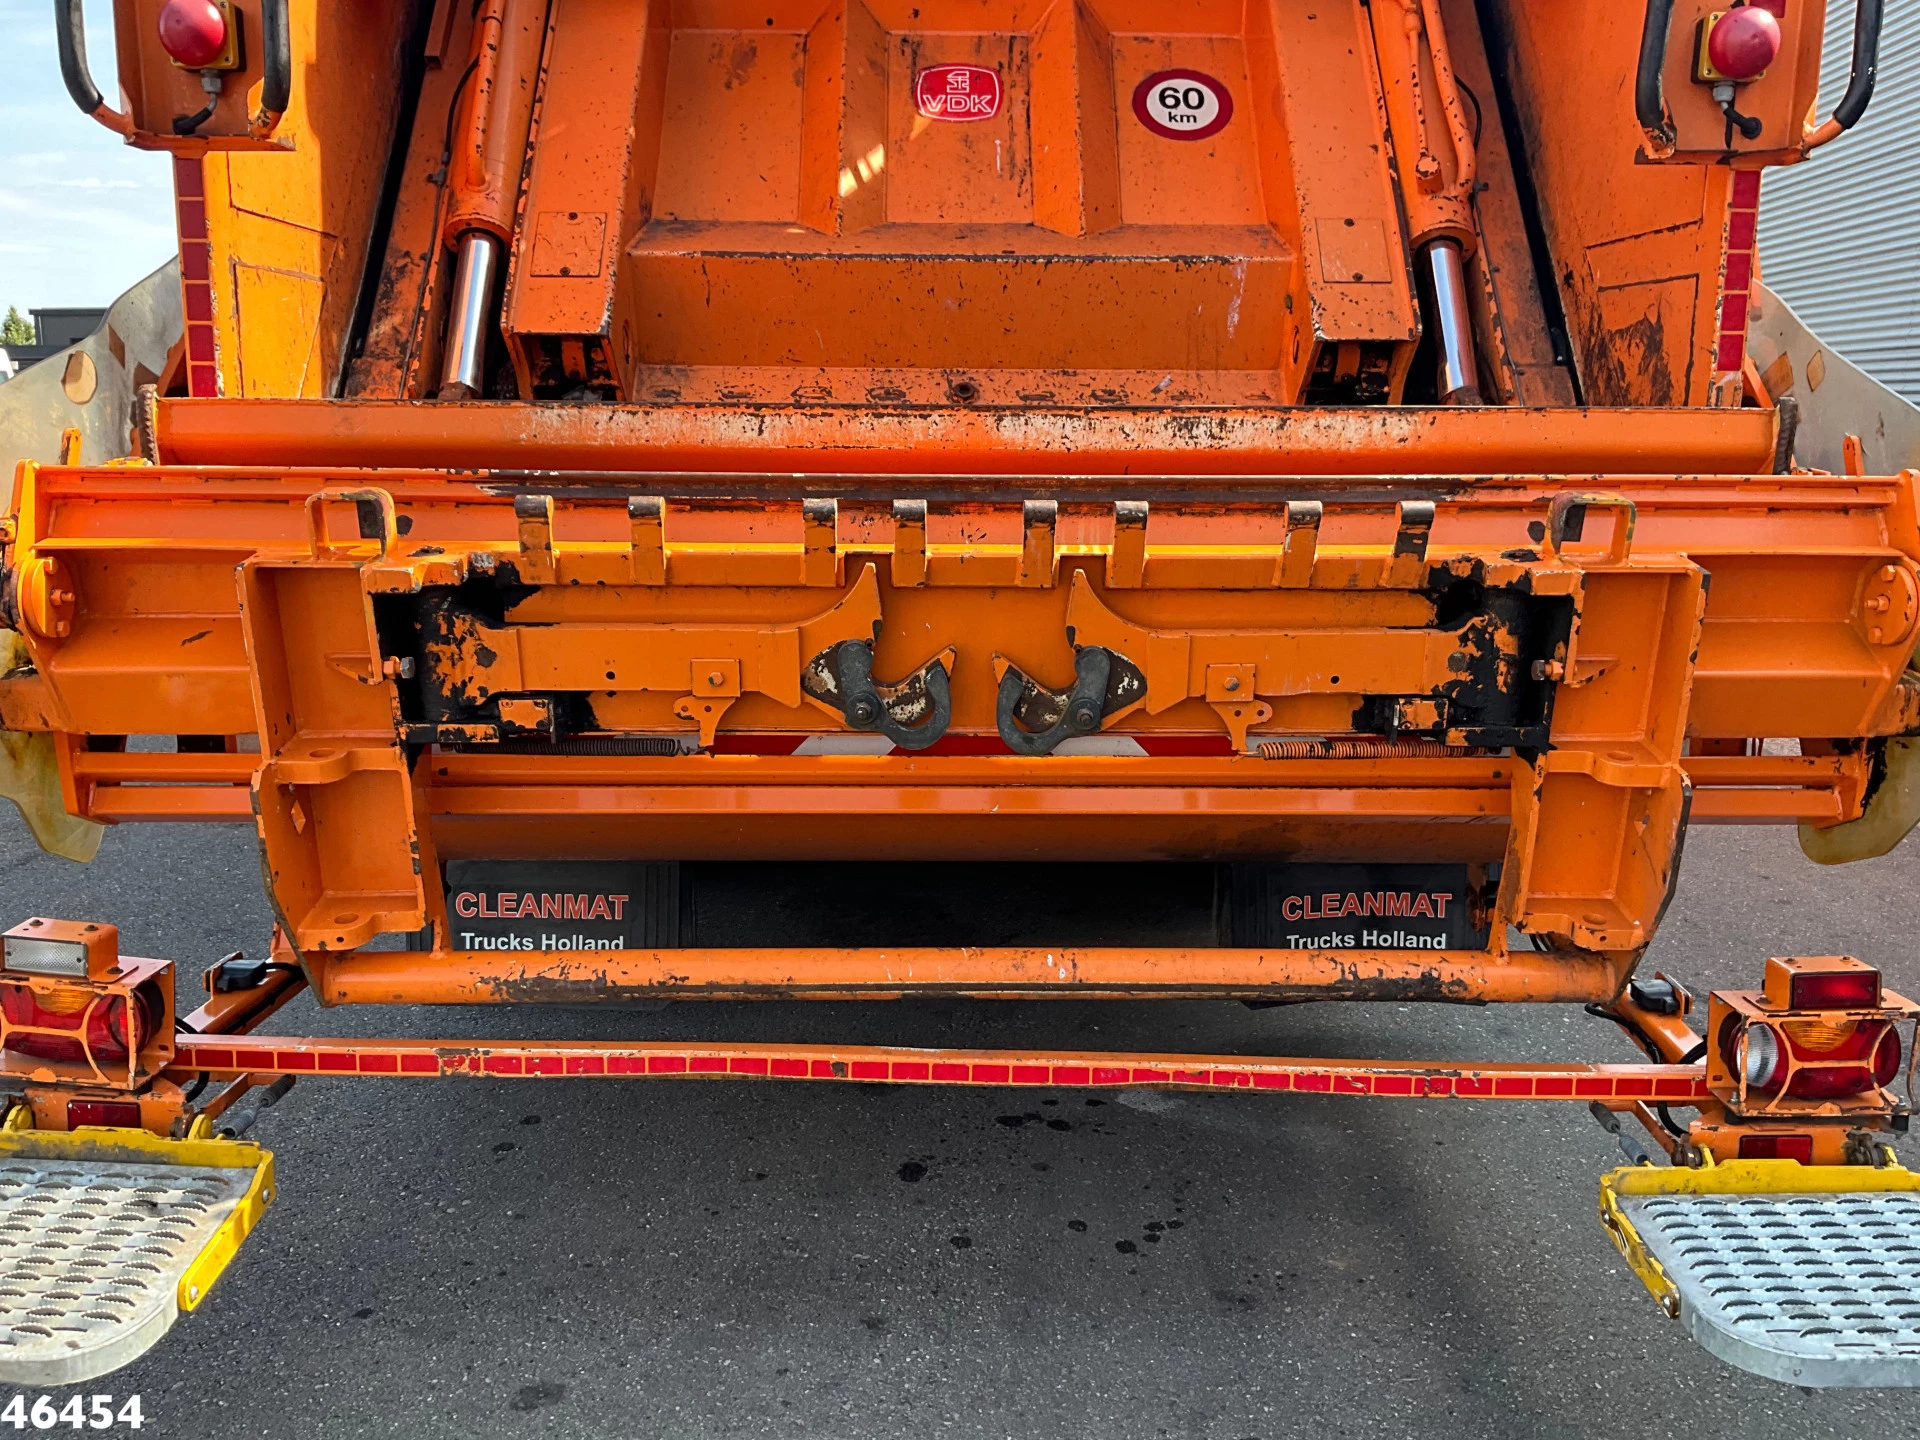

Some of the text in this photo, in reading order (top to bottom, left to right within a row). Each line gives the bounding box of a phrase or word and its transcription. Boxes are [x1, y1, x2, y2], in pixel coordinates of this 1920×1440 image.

[922, 94, 992, 113] VDK
[1158, 86, 1205, 111] 60
[1168, 111, 1198, 123] km
[455, 892, 629, 920] CLEANMAT
[1282, 891, 1453, 921] CLEANMAT
[460, 932, 624, 950] Trucks Holland
[1286, 929, 1447, 950] Trucks Holland
